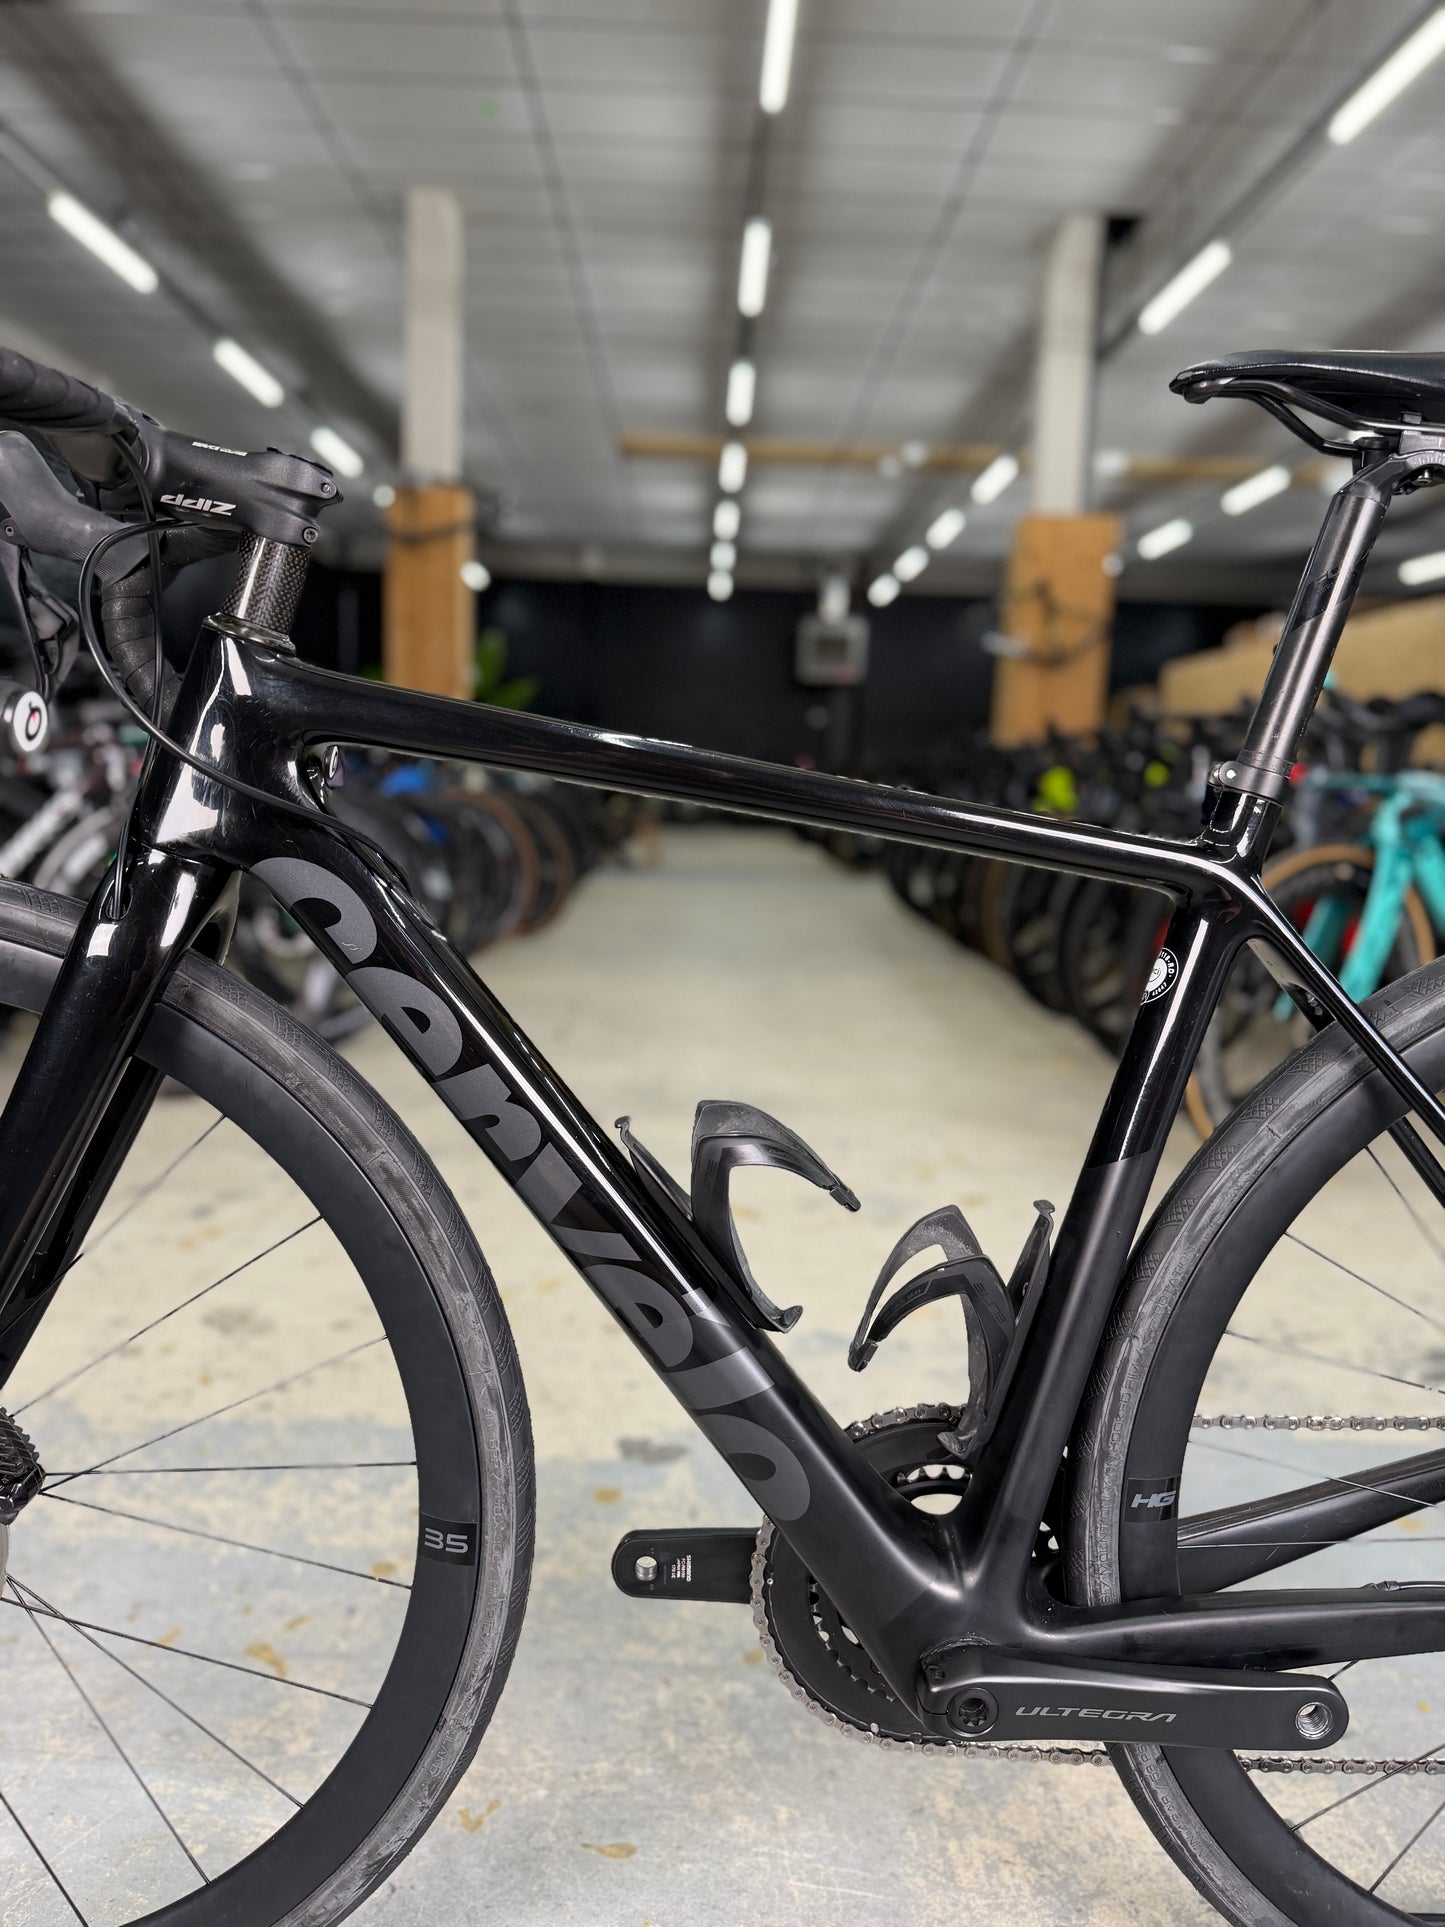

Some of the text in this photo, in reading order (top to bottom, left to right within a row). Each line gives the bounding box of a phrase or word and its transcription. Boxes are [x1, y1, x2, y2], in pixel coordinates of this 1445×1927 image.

[160, 494, 236, 516] ZIPP
[424, 1527, 469, 1554] 35
[1015, 1706, 1178, 1723] ULTEGRA
